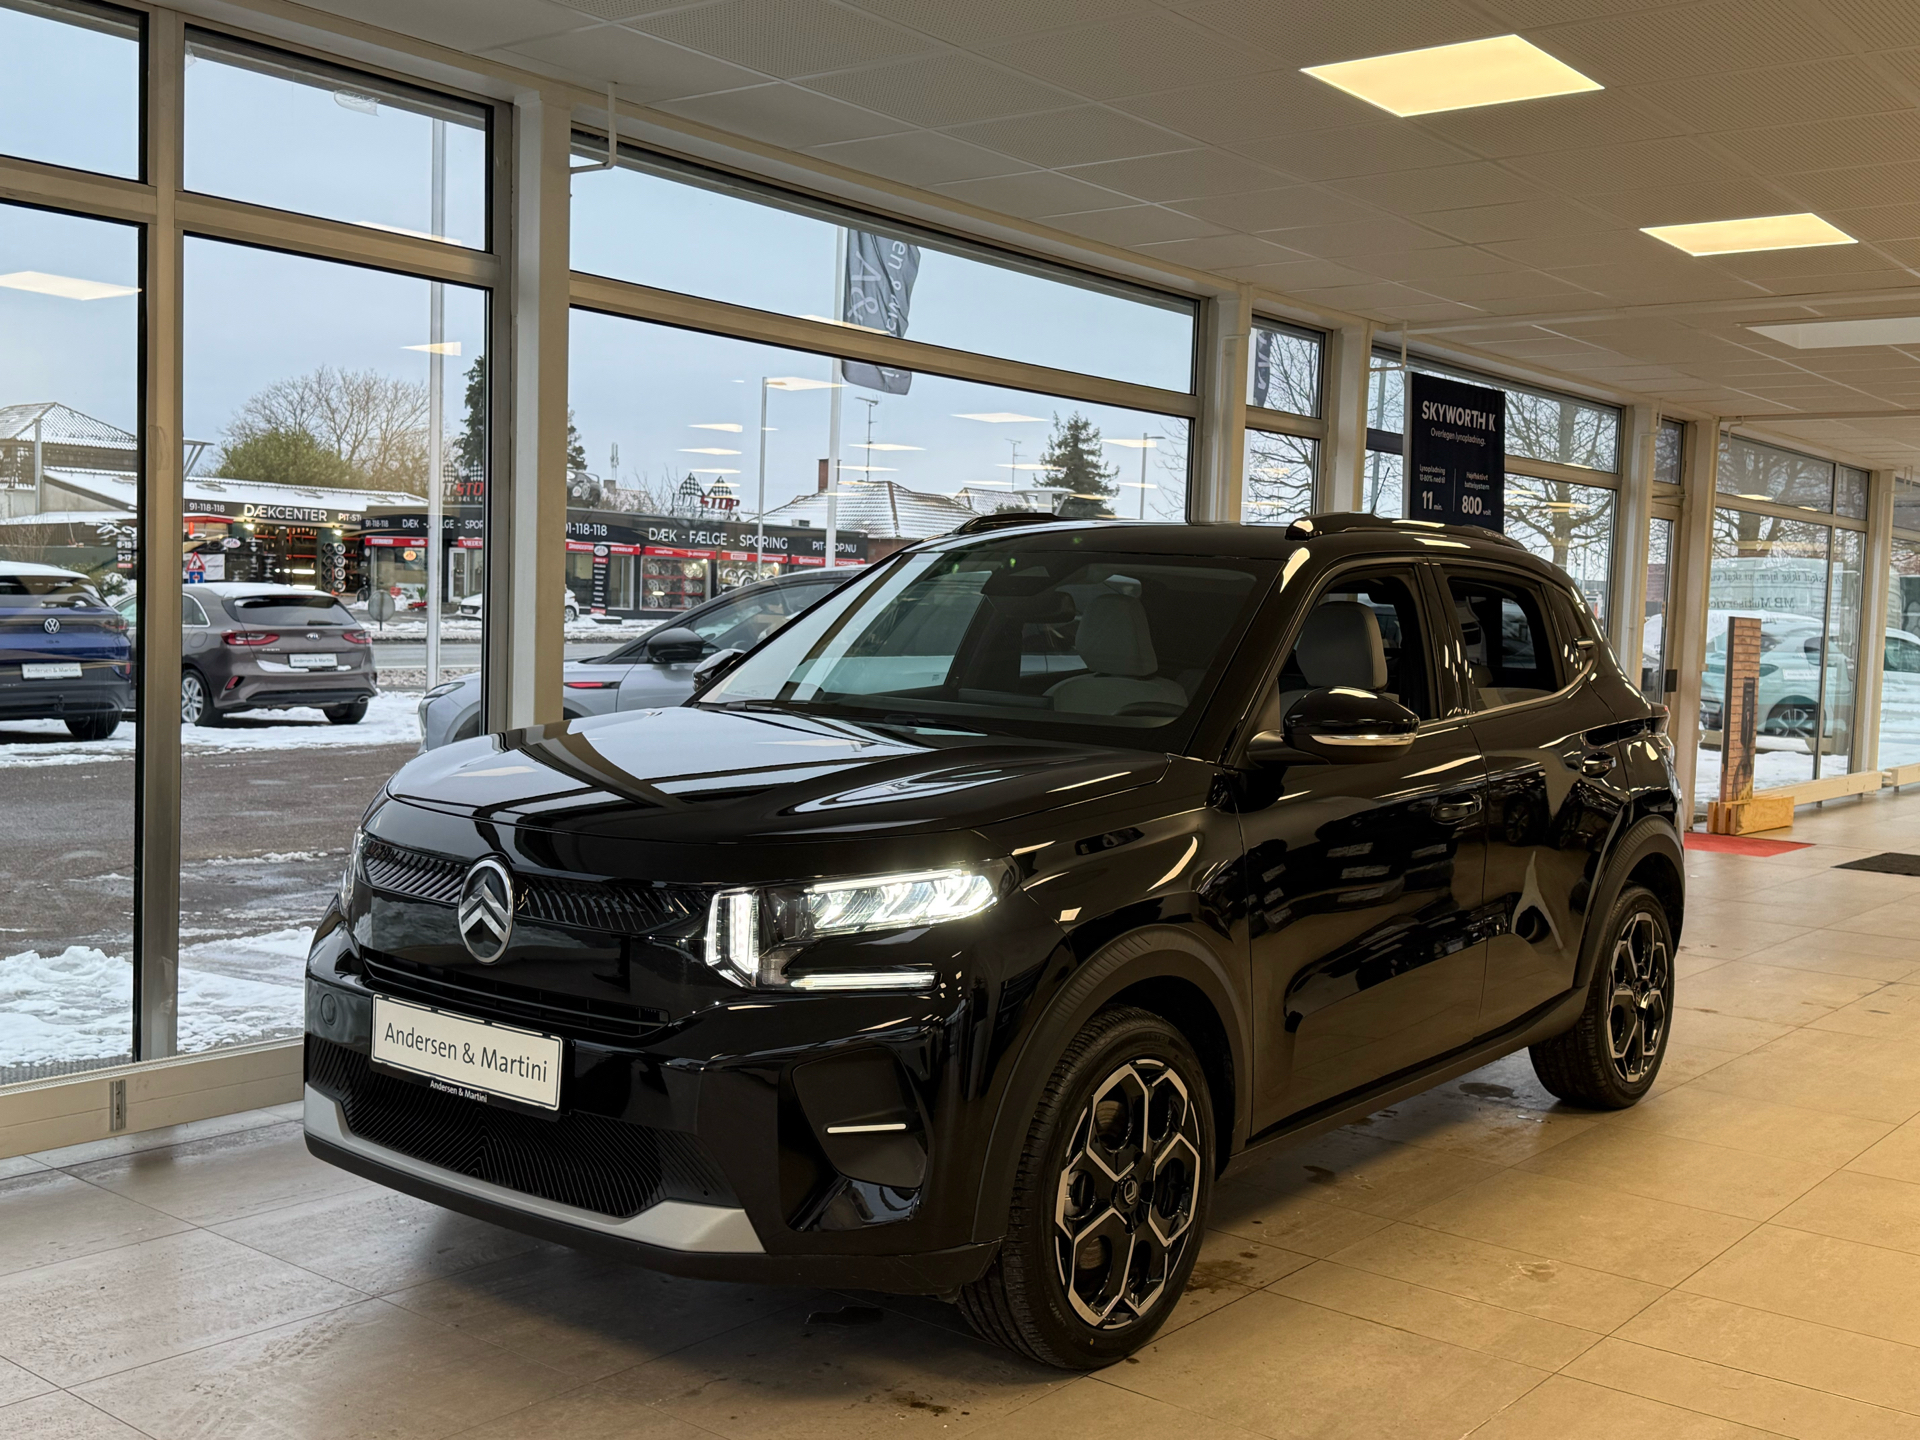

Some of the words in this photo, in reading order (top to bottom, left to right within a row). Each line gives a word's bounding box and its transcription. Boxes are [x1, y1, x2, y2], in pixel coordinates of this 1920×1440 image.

[1421, 400, 1486, 430] SKYWORTH
[1488, 413, 1496, 432] K
[189, 502, 226, 513] 91-118-118
[1422, 490, 1433, 510] 11
[1462, 495, 1483, 515] 800
[243, 503, 328, 522] DÆKCENTER
[365, 519, 389, 528] 91-118-118
[402, 519, 420, 529] DÆK
[648, 527, 677, 543] DÆK
[689, 530, 728, 546] FÆLGE
[739, 534, 789, 550] SPORING
[812, 540, 858, 554] PIT-OP.NU
[384, 1022, 457, 1061] Andersen
[462, 1042, 476, 1066] &
[480, 1046, 548, 1083] Martini
[430, 1080, 457, 1096] Andersen
[457, 1087, 464, 1097] &
[464, 1089, 488, 1104] Martini
